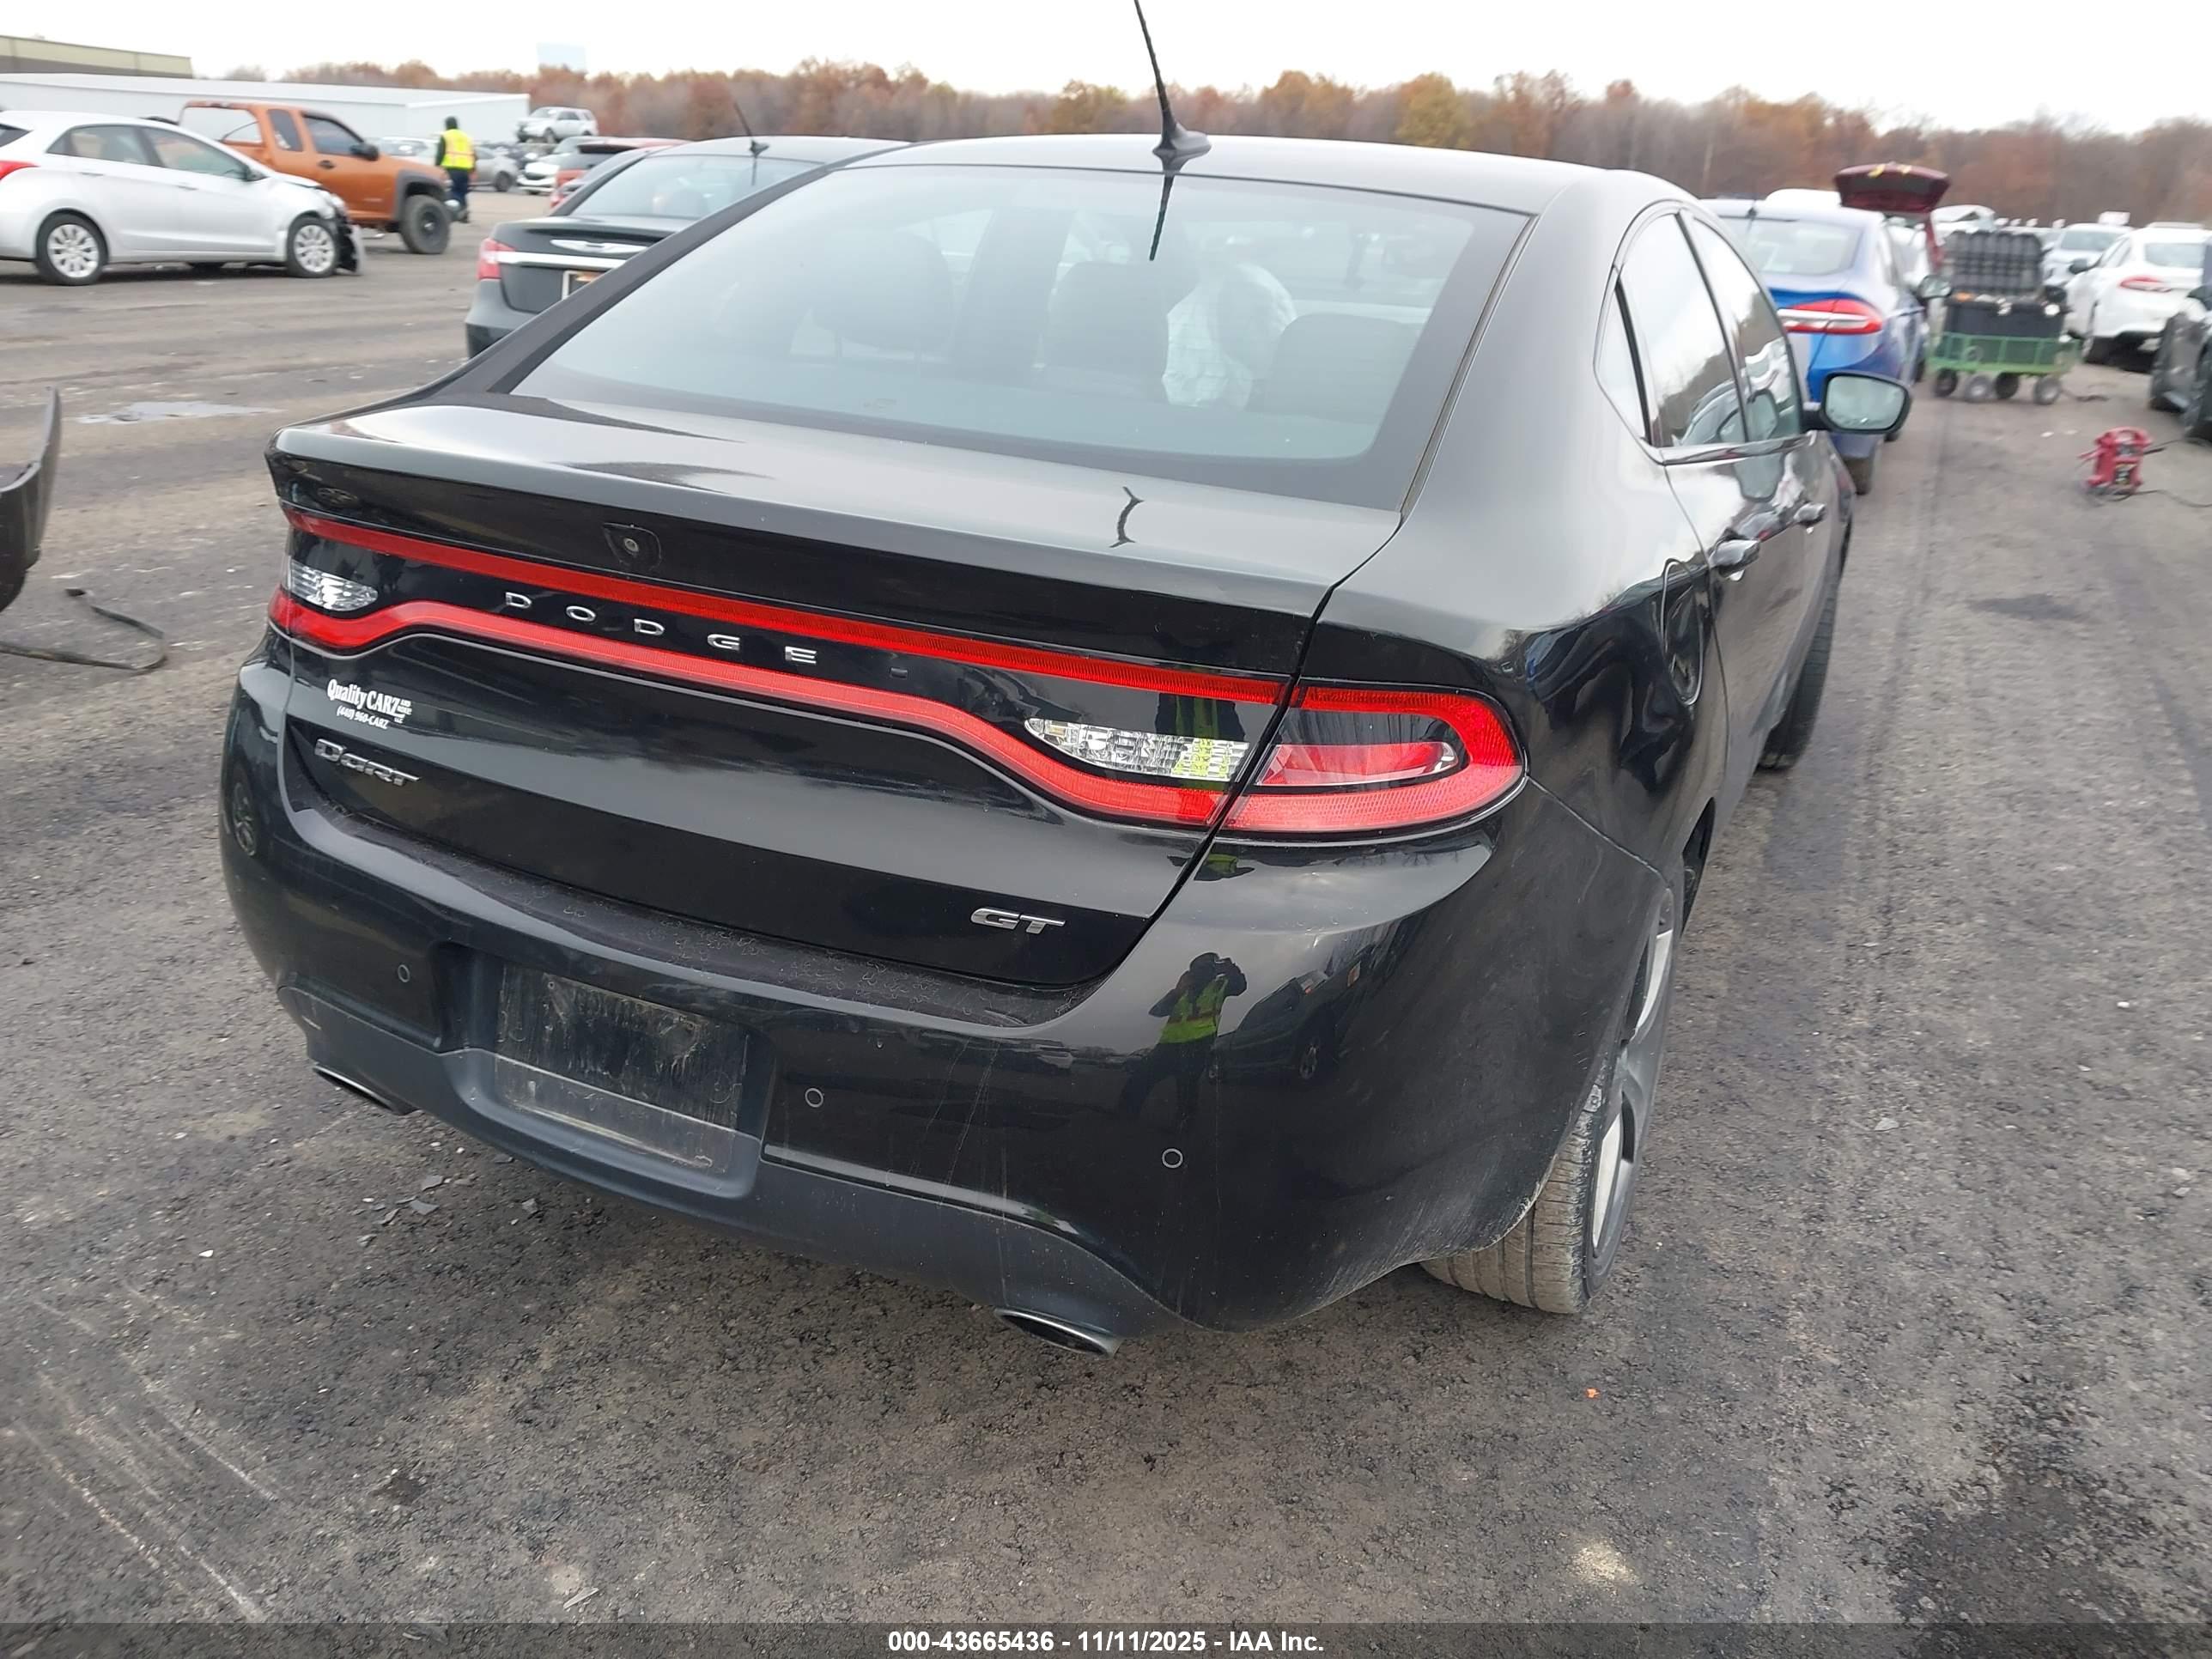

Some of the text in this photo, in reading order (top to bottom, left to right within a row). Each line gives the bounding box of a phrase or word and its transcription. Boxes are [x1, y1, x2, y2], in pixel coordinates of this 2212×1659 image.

[505, 591, 817, 665] DODGE
[327, 678, 405, 719] Quality CARZ
[970, 908, 1066, 934] GT
